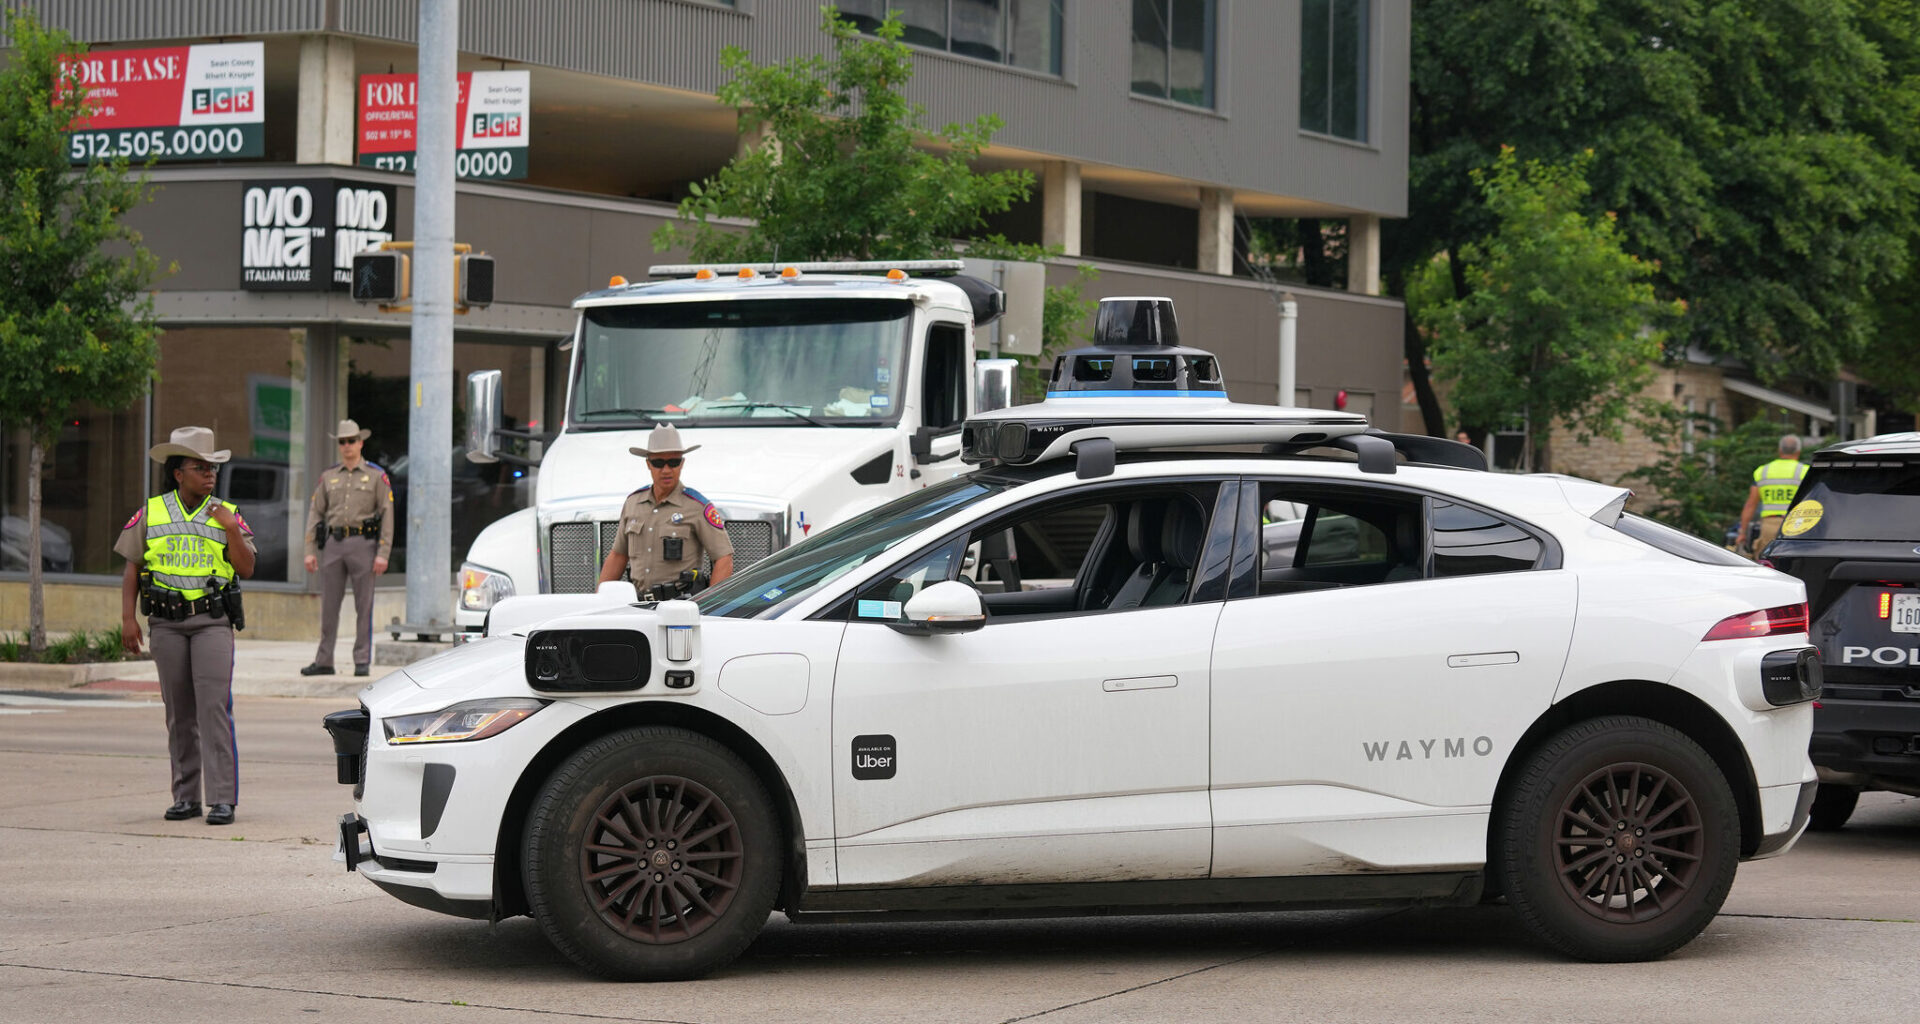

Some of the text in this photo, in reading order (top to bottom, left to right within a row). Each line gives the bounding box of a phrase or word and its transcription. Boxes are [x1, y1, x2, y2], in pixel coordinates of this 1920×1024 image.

[60, 55, 181, 85] FOR LEASE
[210, 60, 229, 68] Sean
[228, 71, 255, 80] Kruger
[195, 92, 250, 111] ECR
[366, 82, 404, 107] FOR
[475, 116, 519, 135] ECR
[71, 128, 244, 159] 512.505.0000
[244, 186, 313, 227] MO
[335, 188, 387, 231] MO
[245, 269, 311, 282] ITALIAN LUXE
[1764, 489, 1794, 501] FIRE
[166, 536, 205, 552] STATE
[157, 552, 214, 568] TROOPER
[1362, 735, 1494, 761] WAYMO
[856, 754, 893, 768] Uber
